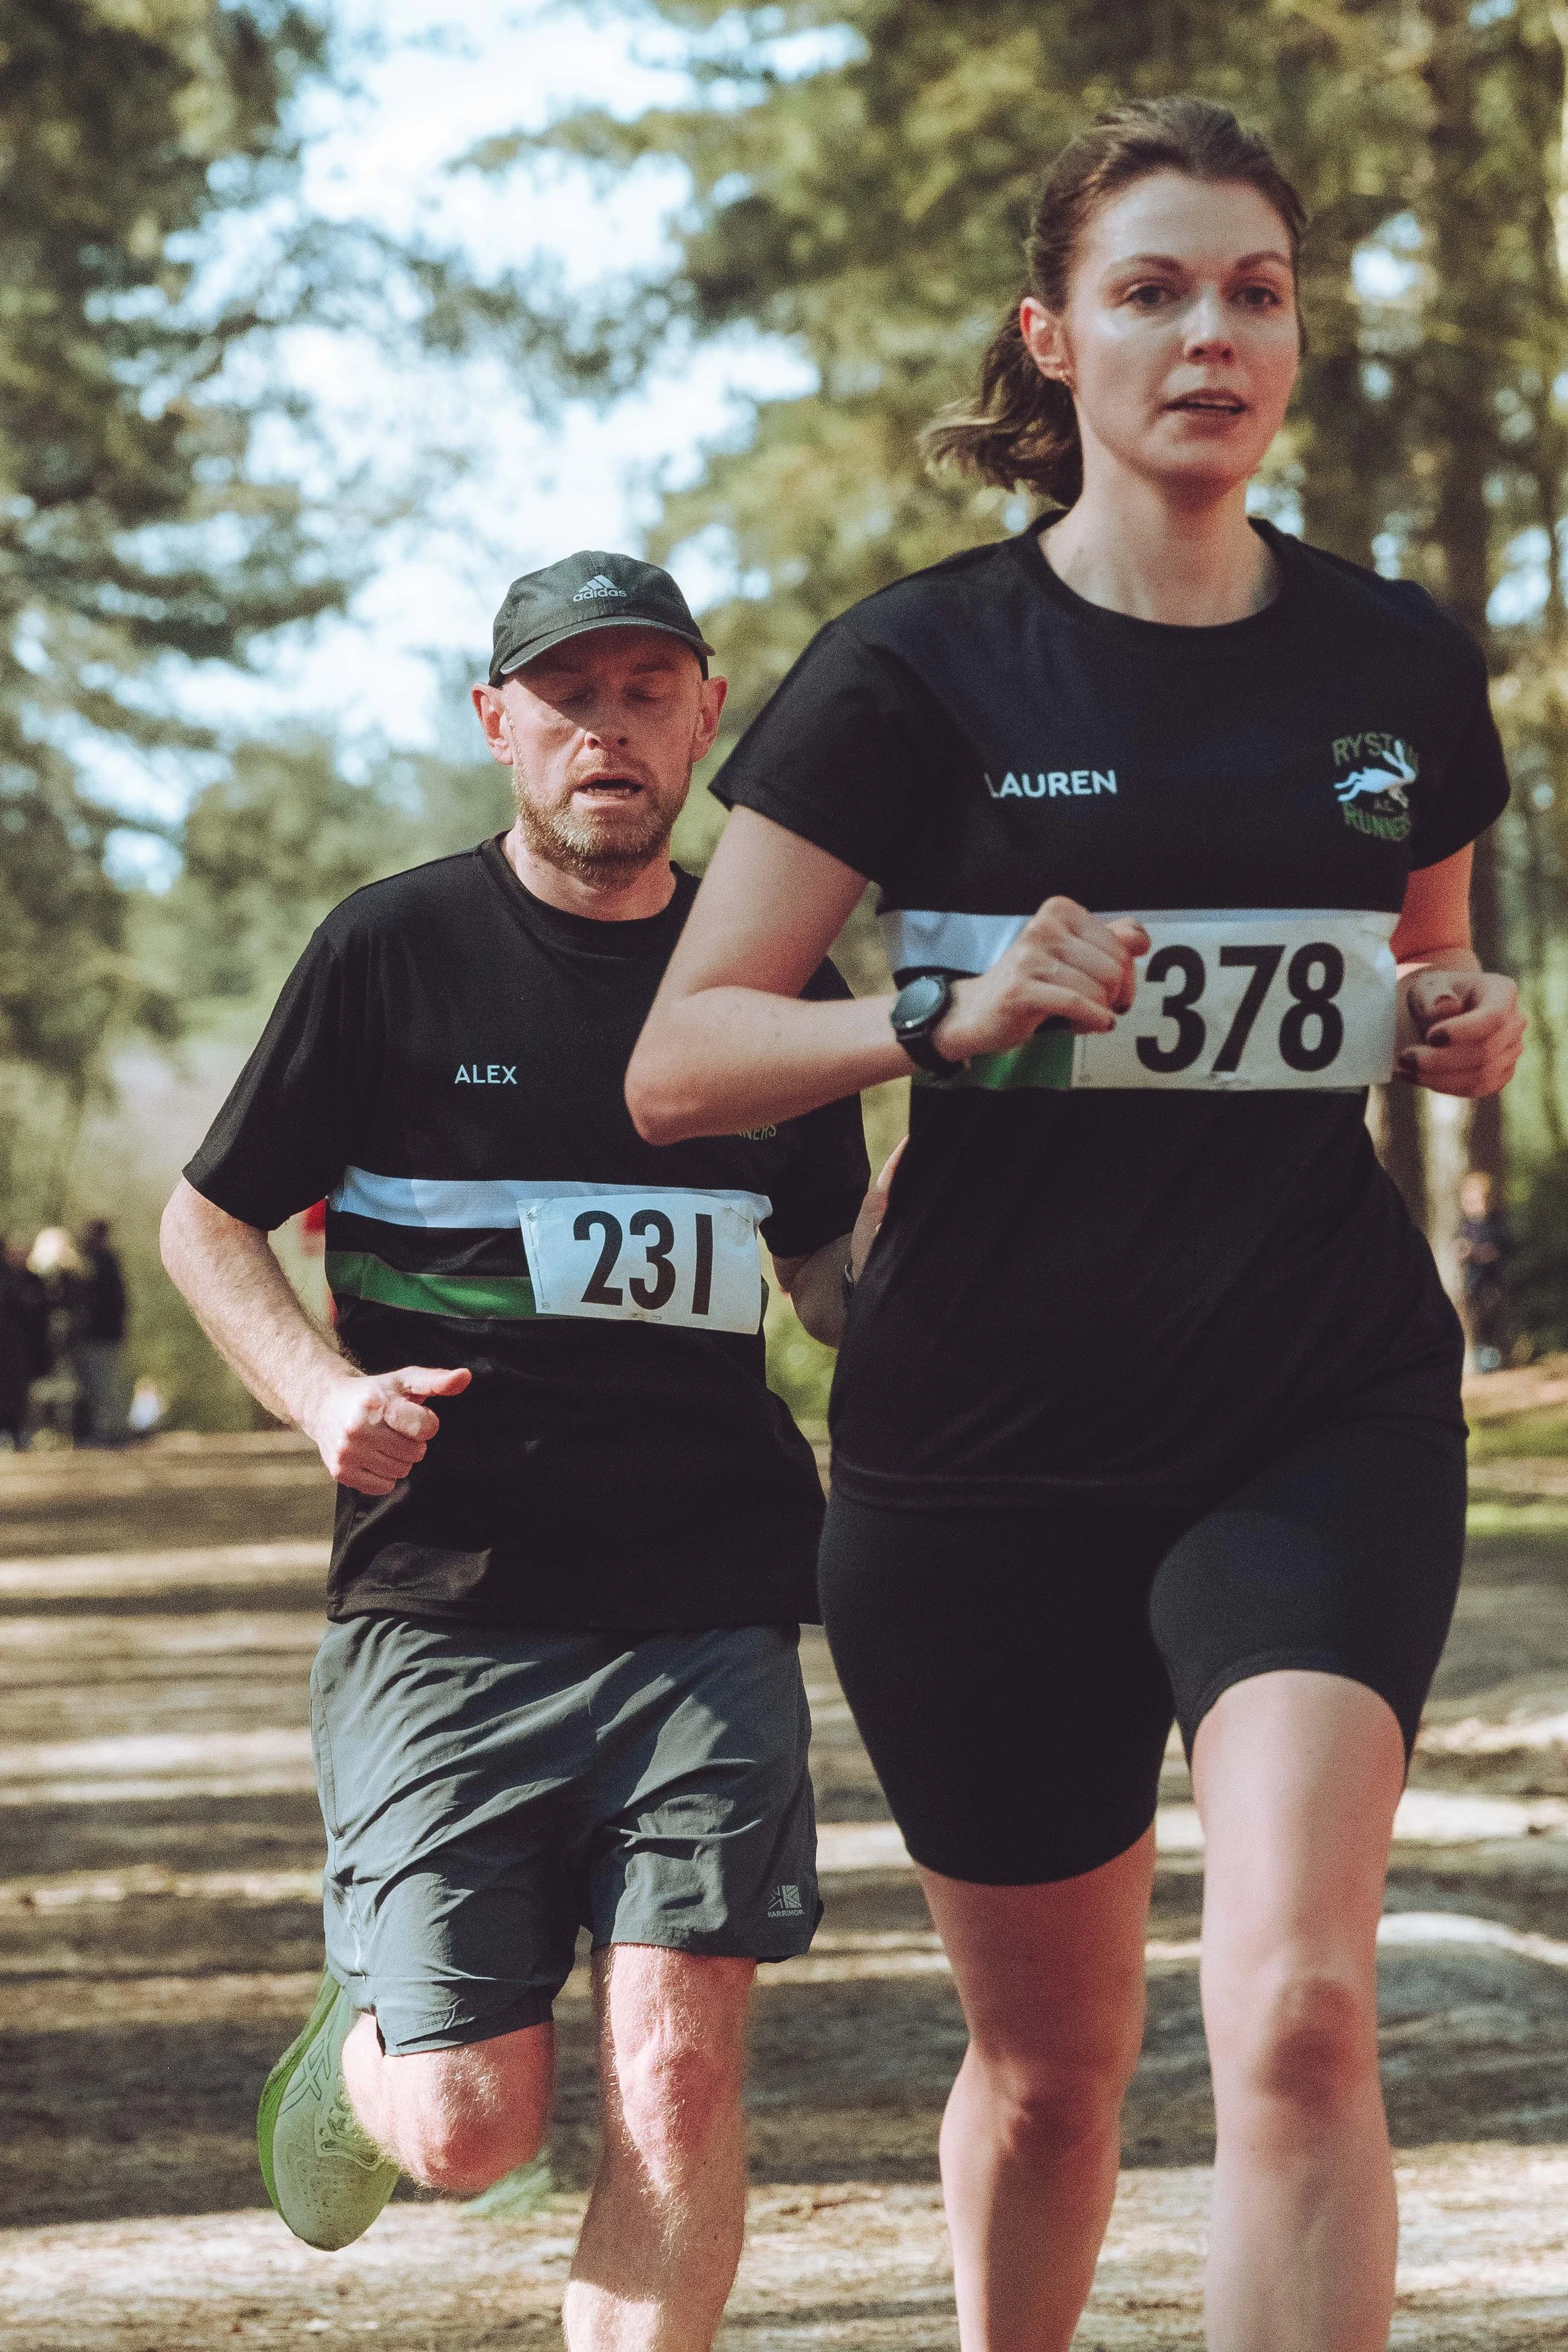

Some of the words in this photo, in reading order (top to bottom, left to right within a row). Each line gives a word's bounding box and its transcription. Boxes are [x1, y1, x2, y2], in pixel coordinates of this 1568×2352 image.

[573, 587, 627, 602] adidas
[1332, 732, 1419, 776] RYST
[983, 769, 1118, 798] LAUREN
[1136, 941, 1345, 1074] 378
[454, 1064, 517, 1084] ALEX
[573, 1209, 713, 1316] 231
[767, 1909, 805, 1918] KARRIMOR
